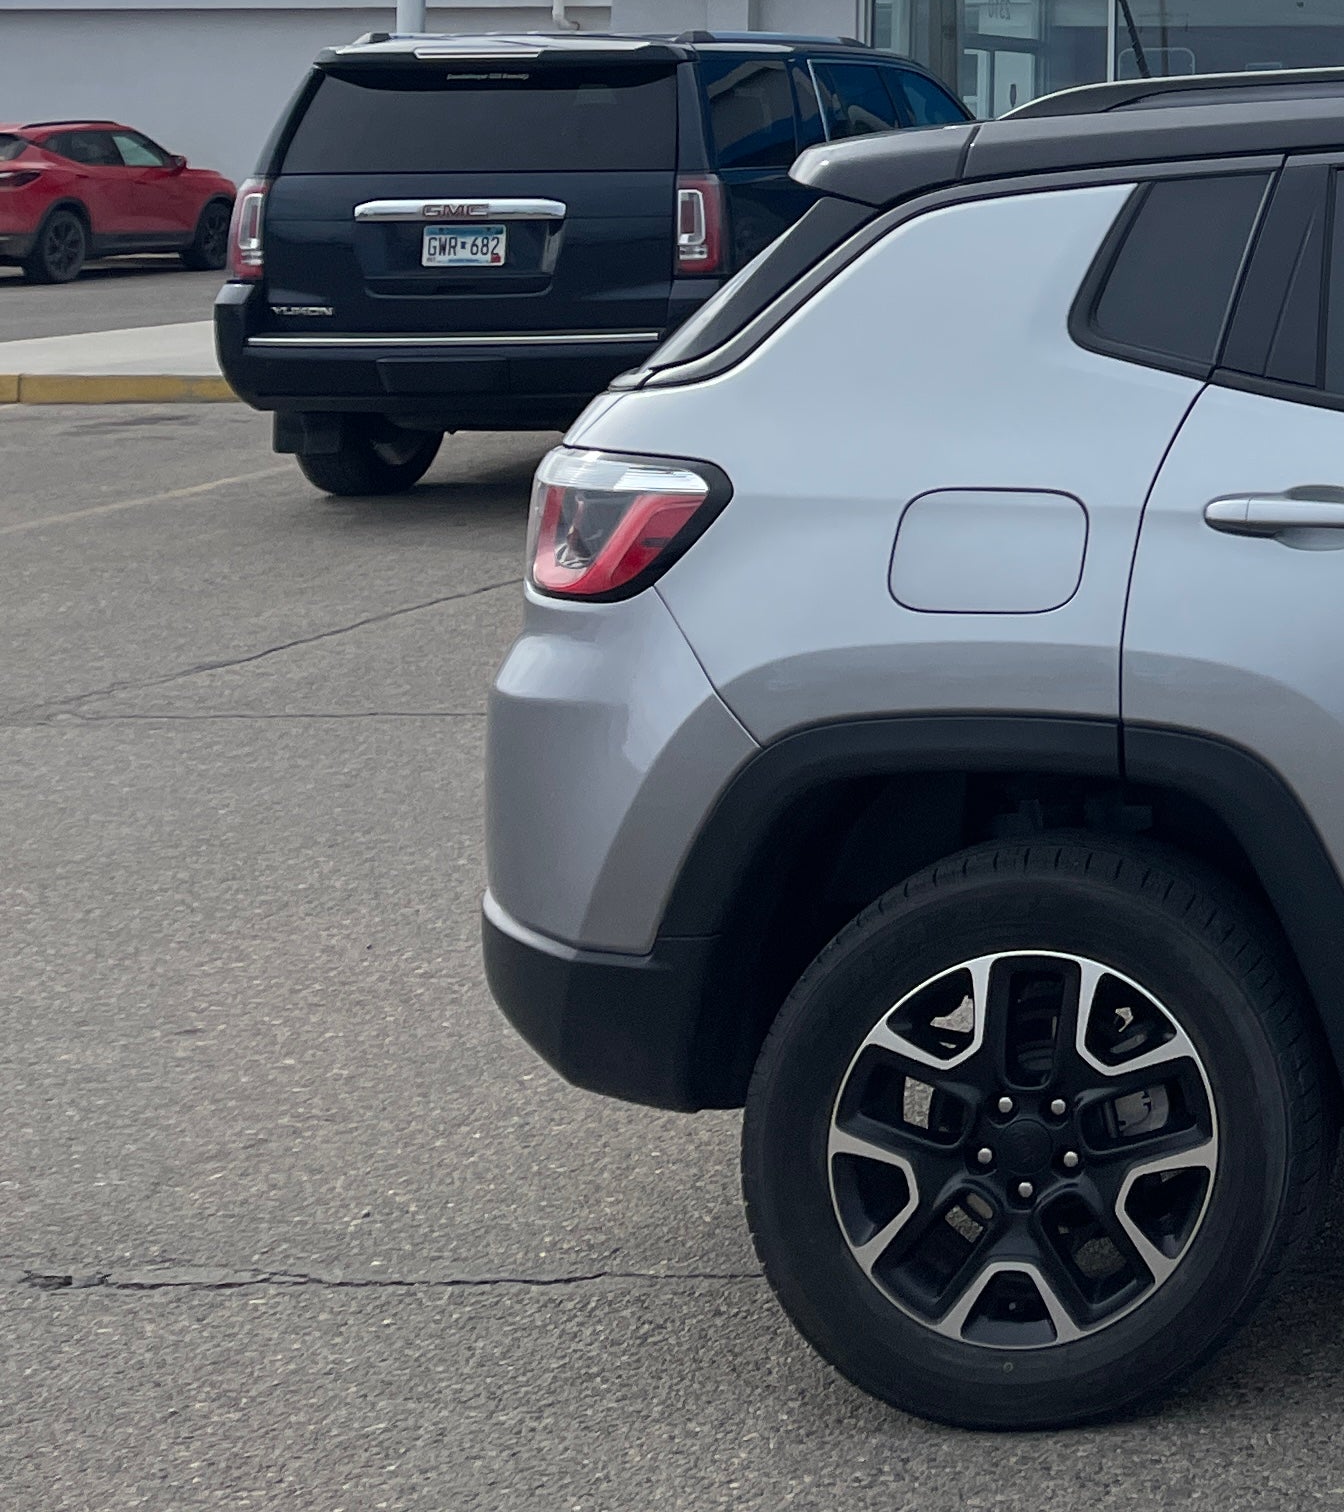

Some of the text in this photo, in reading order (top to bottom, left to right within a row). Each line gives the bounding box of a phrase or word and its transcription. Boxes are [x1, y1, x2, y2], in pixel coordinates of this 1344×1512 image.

[423, 203, 489, 217] GMC
[427, 236, 500, 257] GWR 682
[271, 306, 334, 316] YUKON
